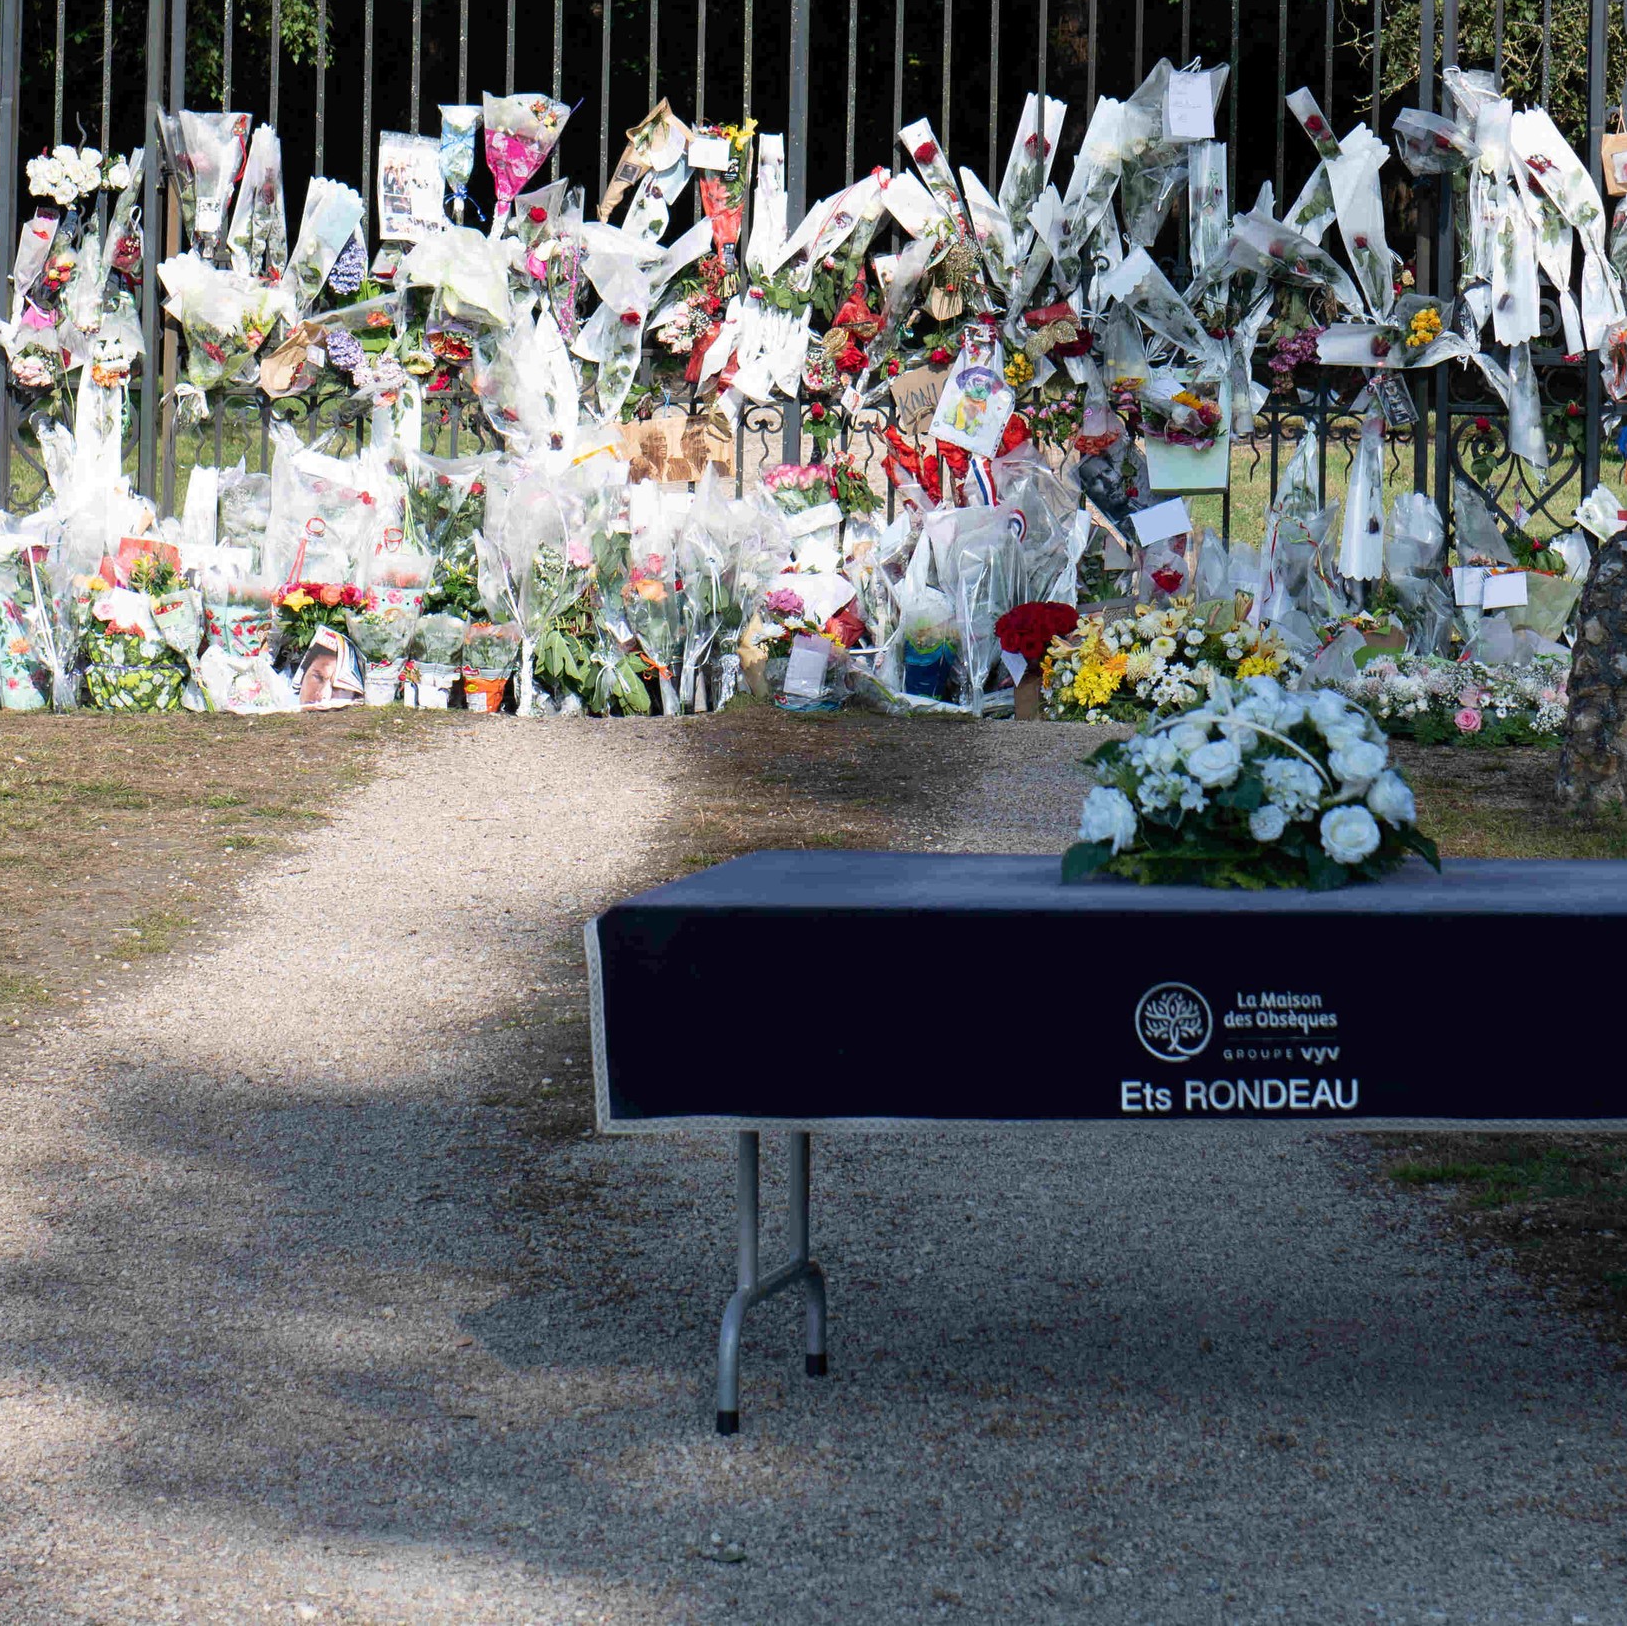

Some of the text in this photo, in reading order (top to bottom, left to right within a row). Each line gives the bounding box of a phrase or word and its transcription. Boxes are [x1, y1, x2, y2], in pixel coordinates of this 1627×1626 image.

[1237, 990, 1323, 1009] La Maison
[1223, 1009, 1338, 1034] des Obsèques
[1222, 1048, 1294, 1061] GROUPE
[1121, 1078, 1360, 1112] Ets RONDEAU
